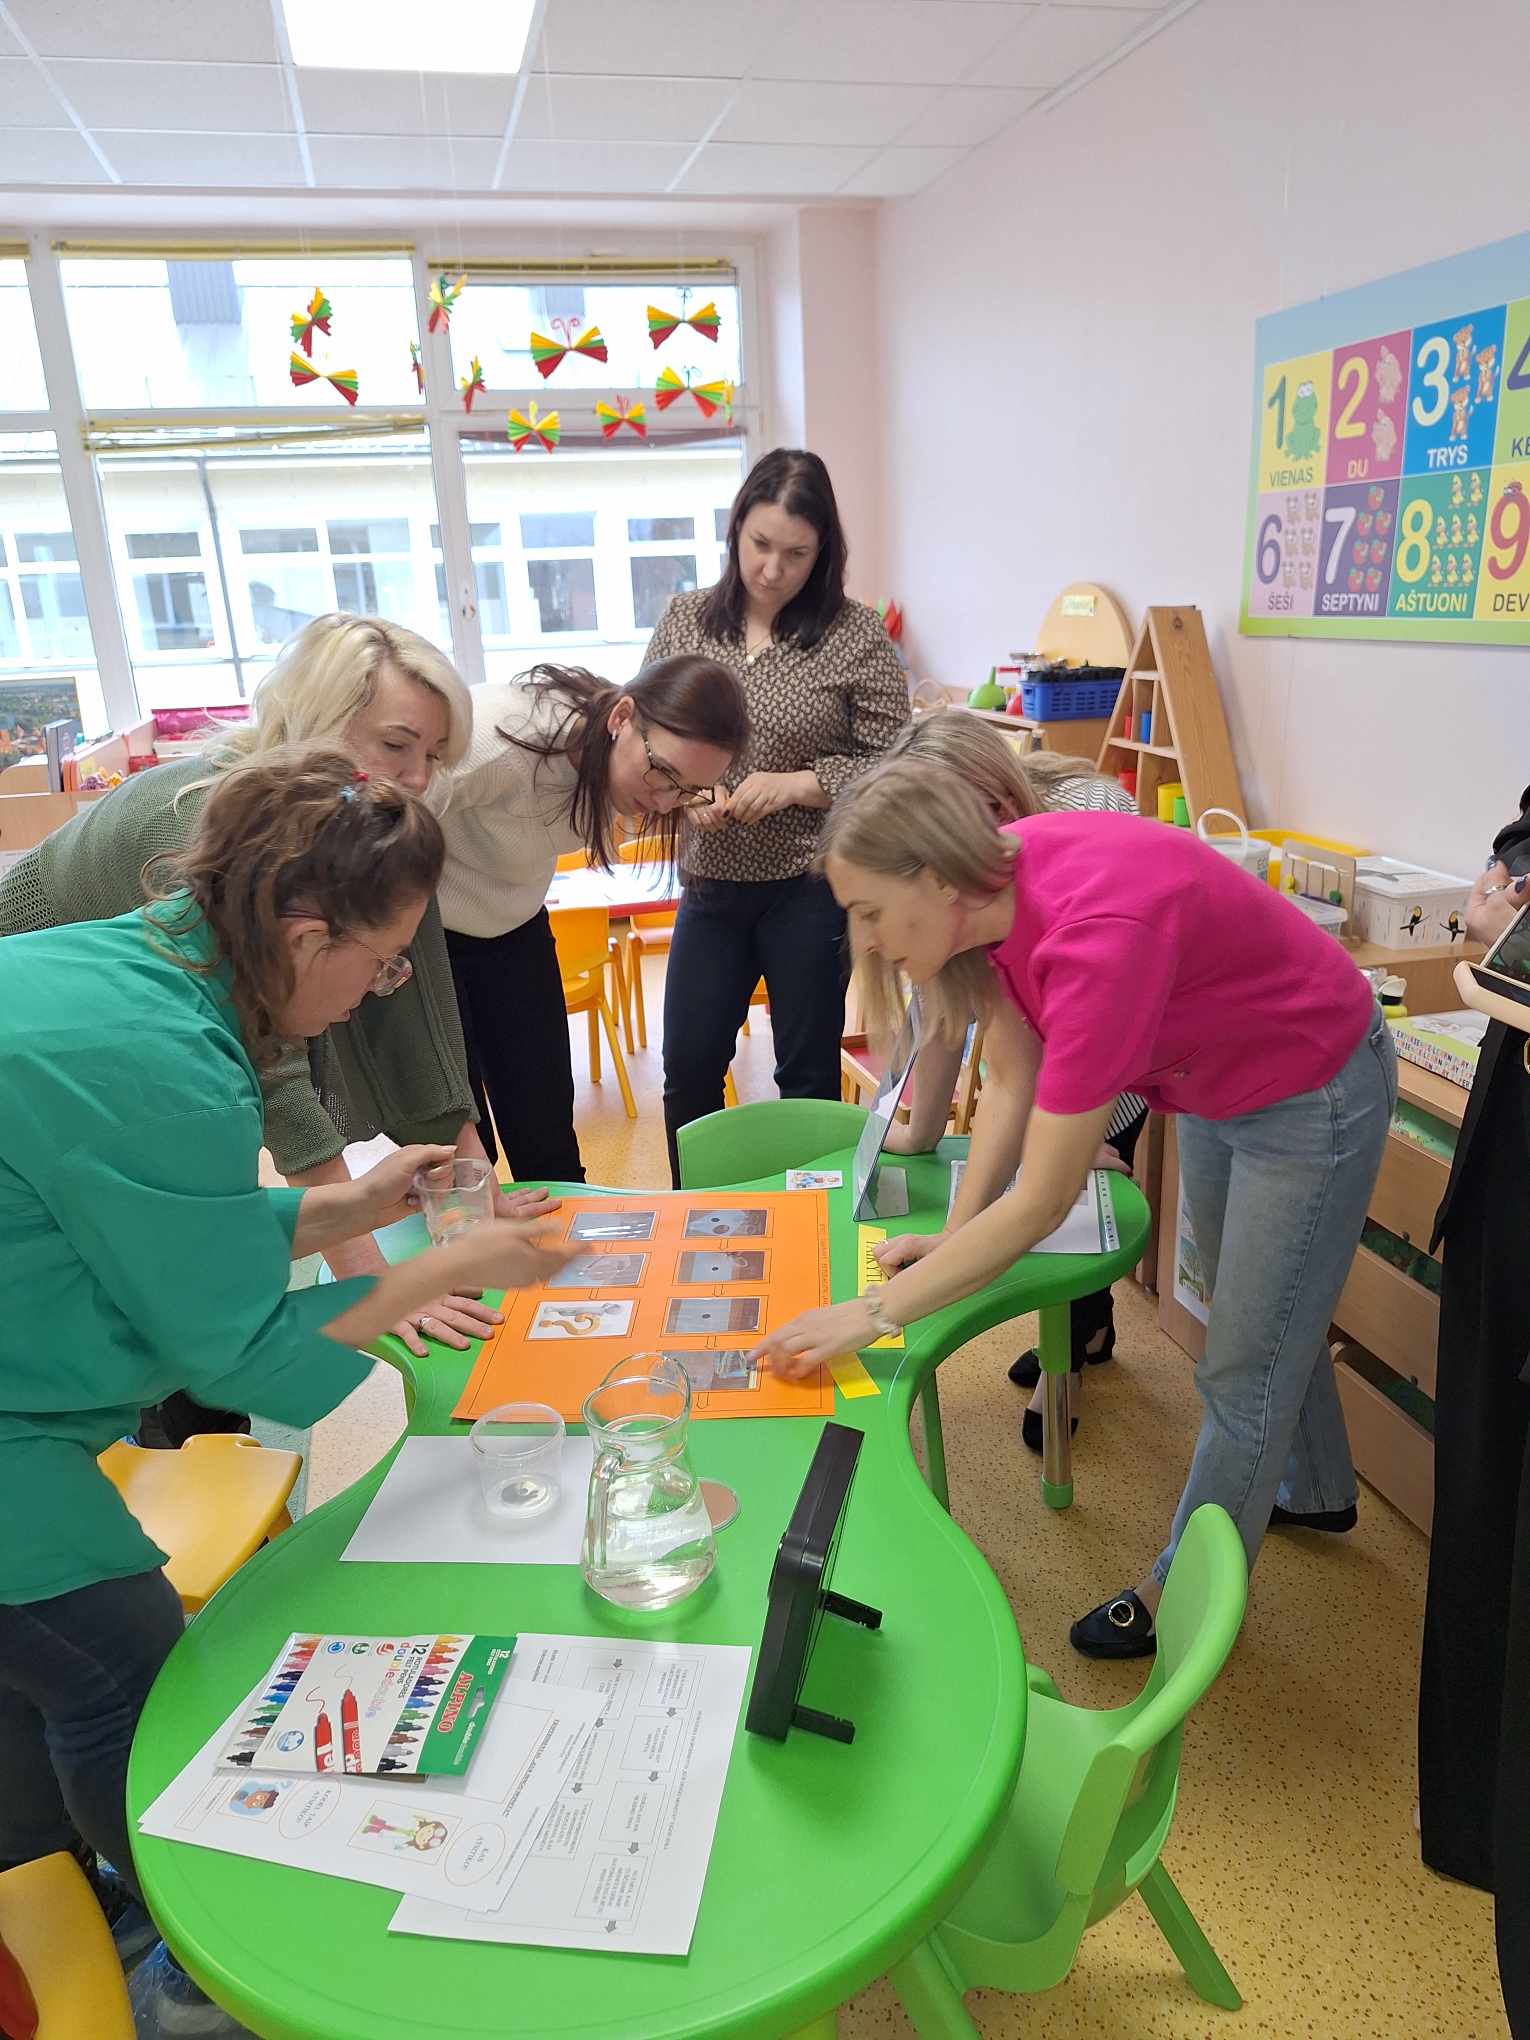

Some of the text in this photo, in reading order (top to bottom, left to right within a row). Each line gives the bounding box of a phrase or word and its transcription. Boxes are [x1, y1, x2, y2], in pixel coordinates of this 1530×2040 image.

[1334, 356, 1370, 440] 2
[1411, 336, 1450, 427] 3
[1267, 375, 1287, 449] 1
[1269, 467, 1313, 487] VIENAS
[1347, 459, 1369, 479] DU
[1426, 444, 1468, 469] TRYS
[1256, 513, 1282, 585] 6
[1324, 506, 1357, 585] 7
[1396, 498, 1432, 584] 8
[1487, 493, 1530, 581] 9
[1321, 592, 1380, 612] SEPTYNI
[1396, 590, 1467, 613] AŠTUONI
[1493, 593, 1530, 612] DEV
[411, 1643, 430, 1655] 12
[499, 1649, 511, 1659] 12
[437, 1670, 474, 1733] ALPINO
